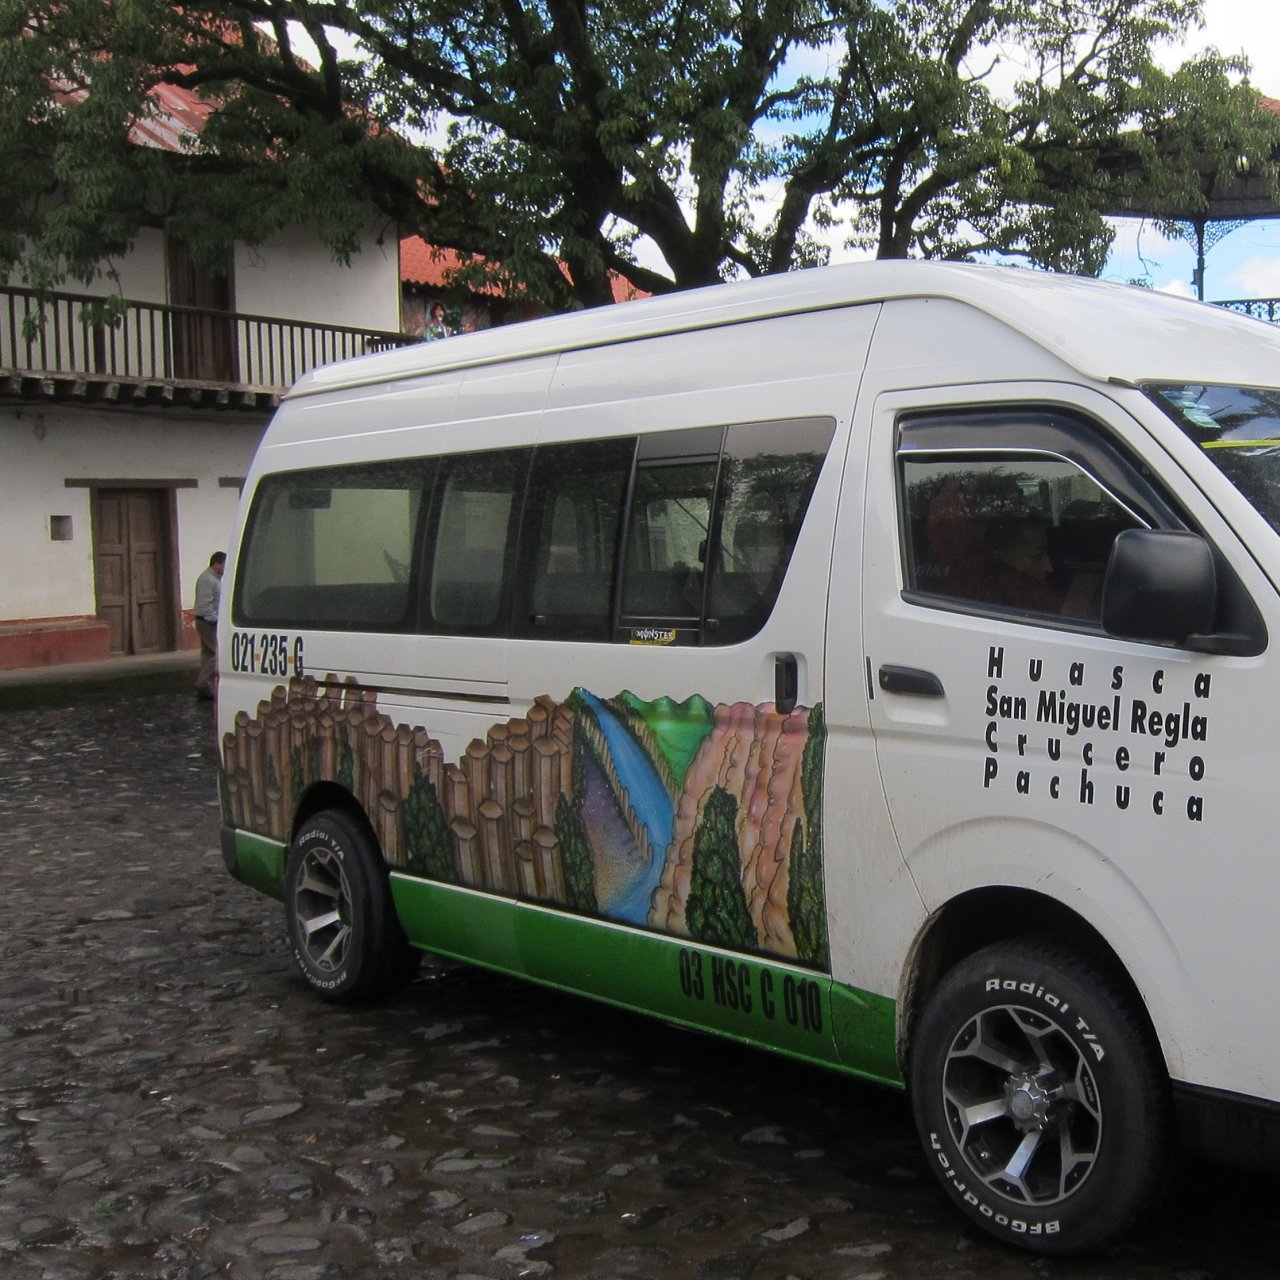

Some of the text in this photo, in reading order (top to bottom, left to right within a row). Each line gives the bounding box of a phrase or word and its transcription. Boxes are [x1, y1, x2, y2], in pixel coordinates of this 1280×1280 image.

[987, 646, 1211, 699] Huasca
[985, 684, 1208, 748] San Miguel Regla
[985, 721, 1205, 782] Crucero
[983, 756, 1204, 822] Pachuca
[299, 829, 328, 846] Radial
[679, 948, 823, 1034] 03 HSC C 010
[985, 978, 1105, 1062] Radial T/A
[930, 1132, 1061, 1235] BFGoodrich
